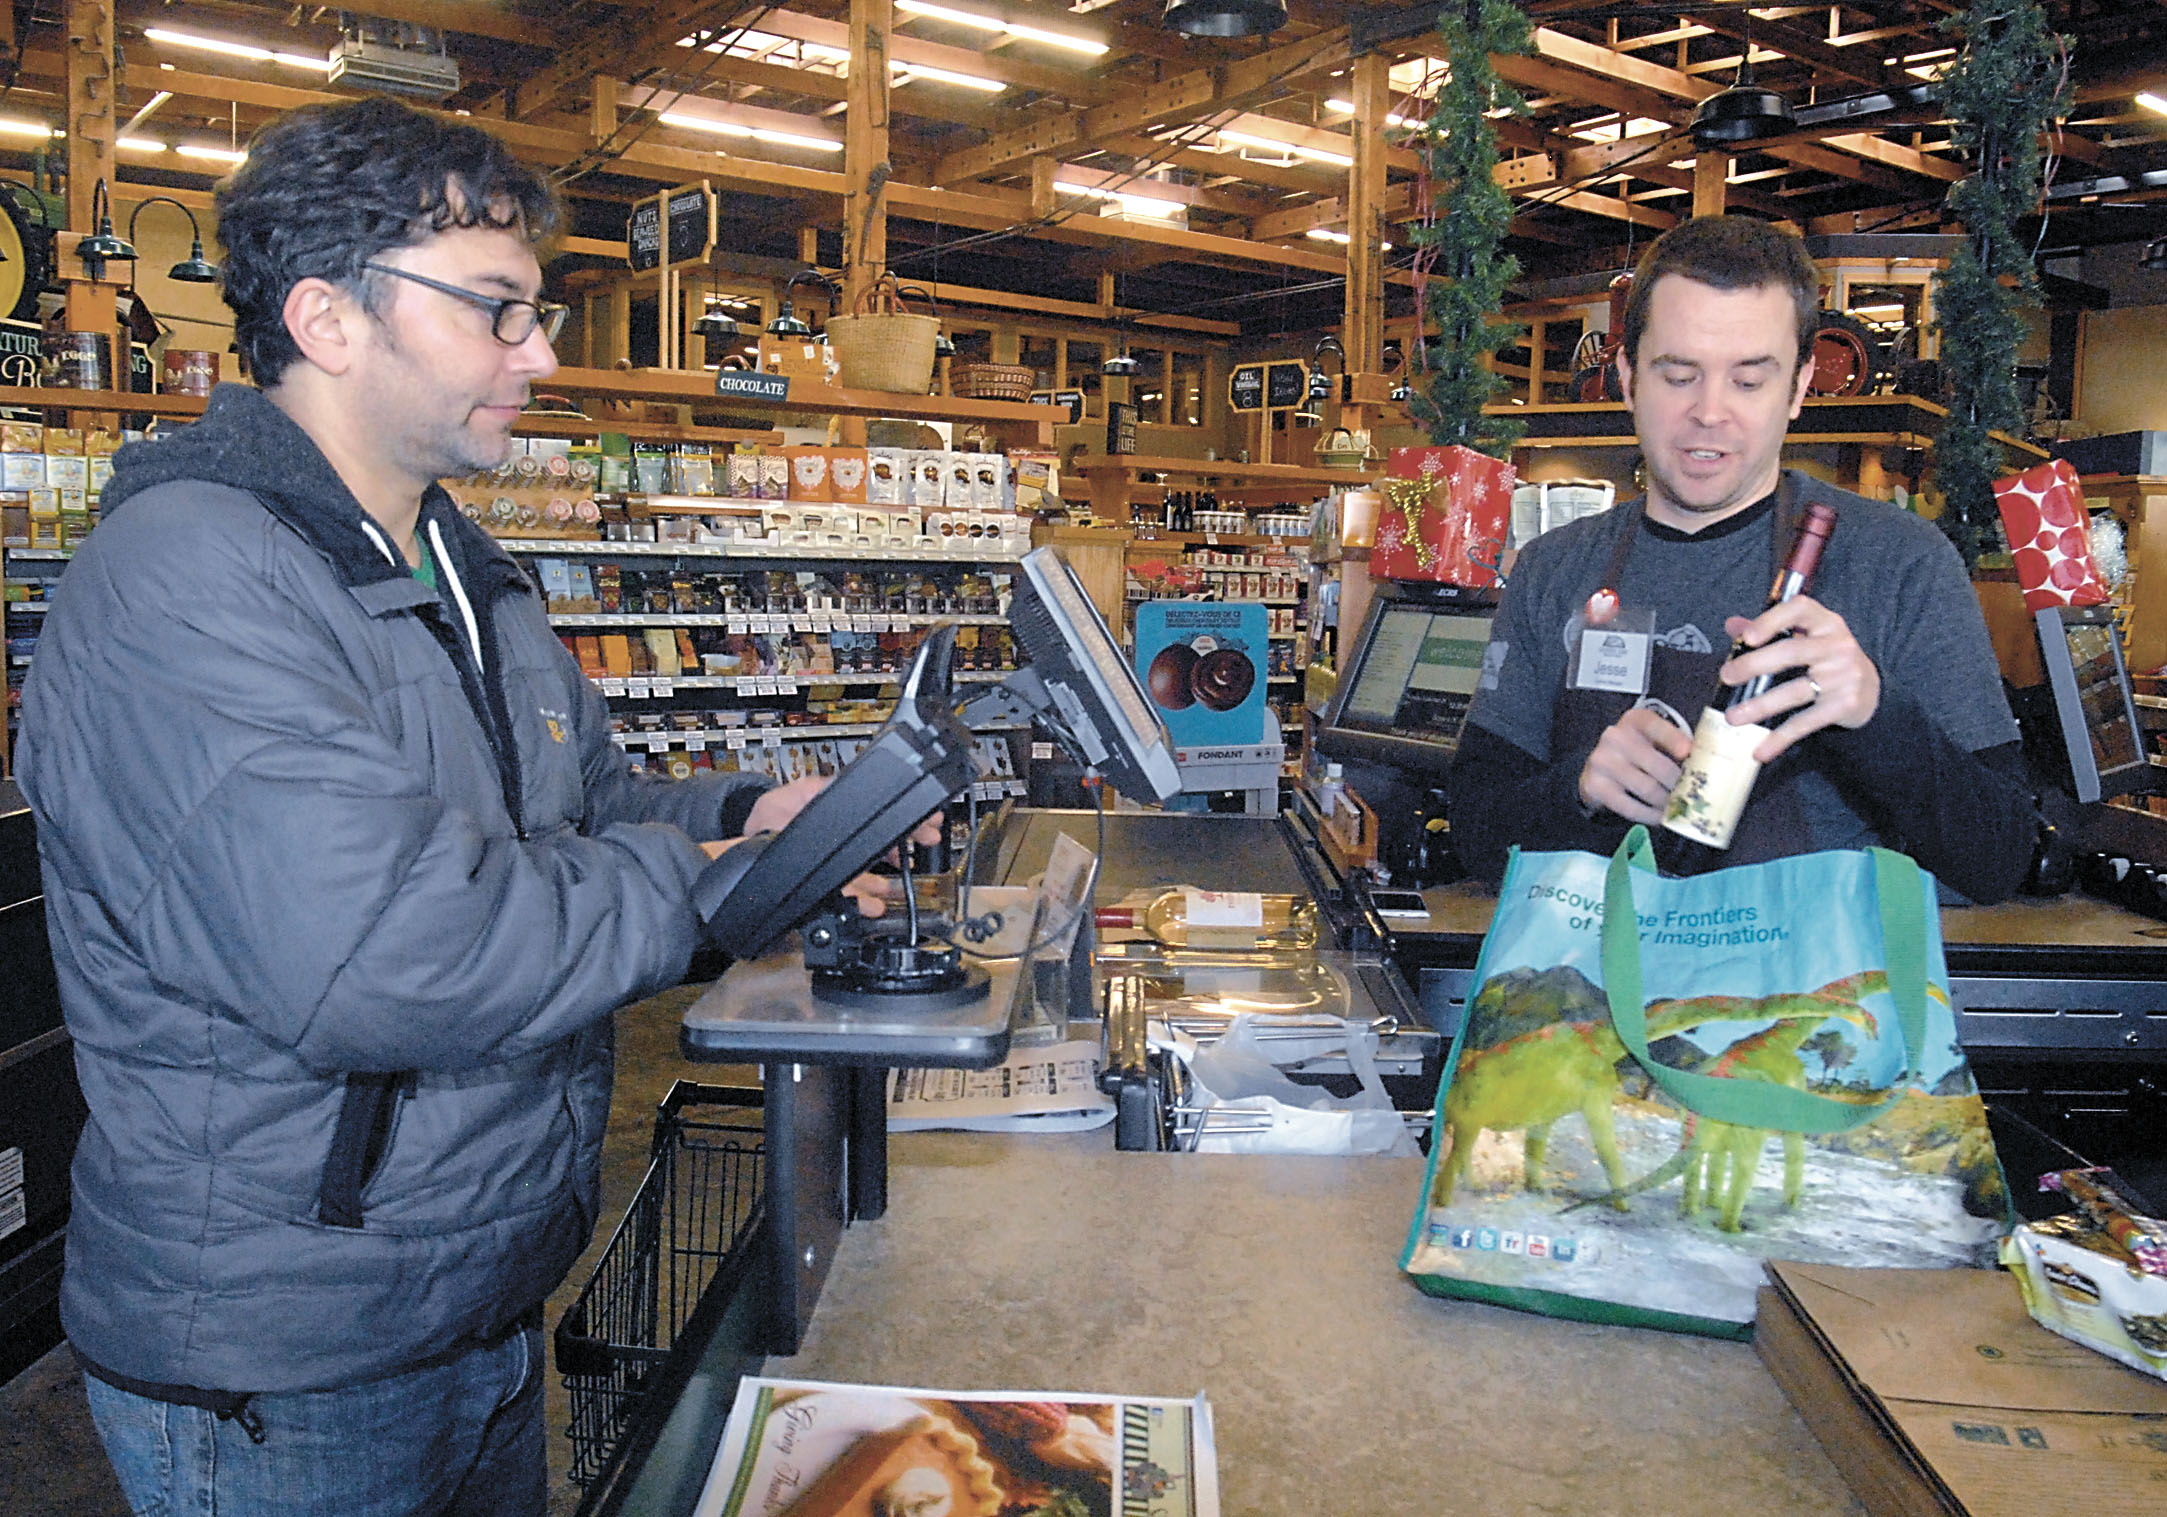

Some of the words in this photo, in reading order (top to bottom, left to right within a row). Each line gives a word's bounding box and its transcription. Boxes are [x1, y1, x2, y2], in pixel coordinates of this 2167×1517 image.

[0, 331, 43, 357] TUR
[1239, 371, 1254, 380] OIL
[720, 377, 785, 395] CHOCOLATE
[1594, 660, 1628, 677] Jesse
[1198, 750, 1243, 760] FONDANT
[1527, 884, 1605, 916] Discove
[1664, 906, 1758, 928] Frontiers
[1569, 915, 1593, 931] of
